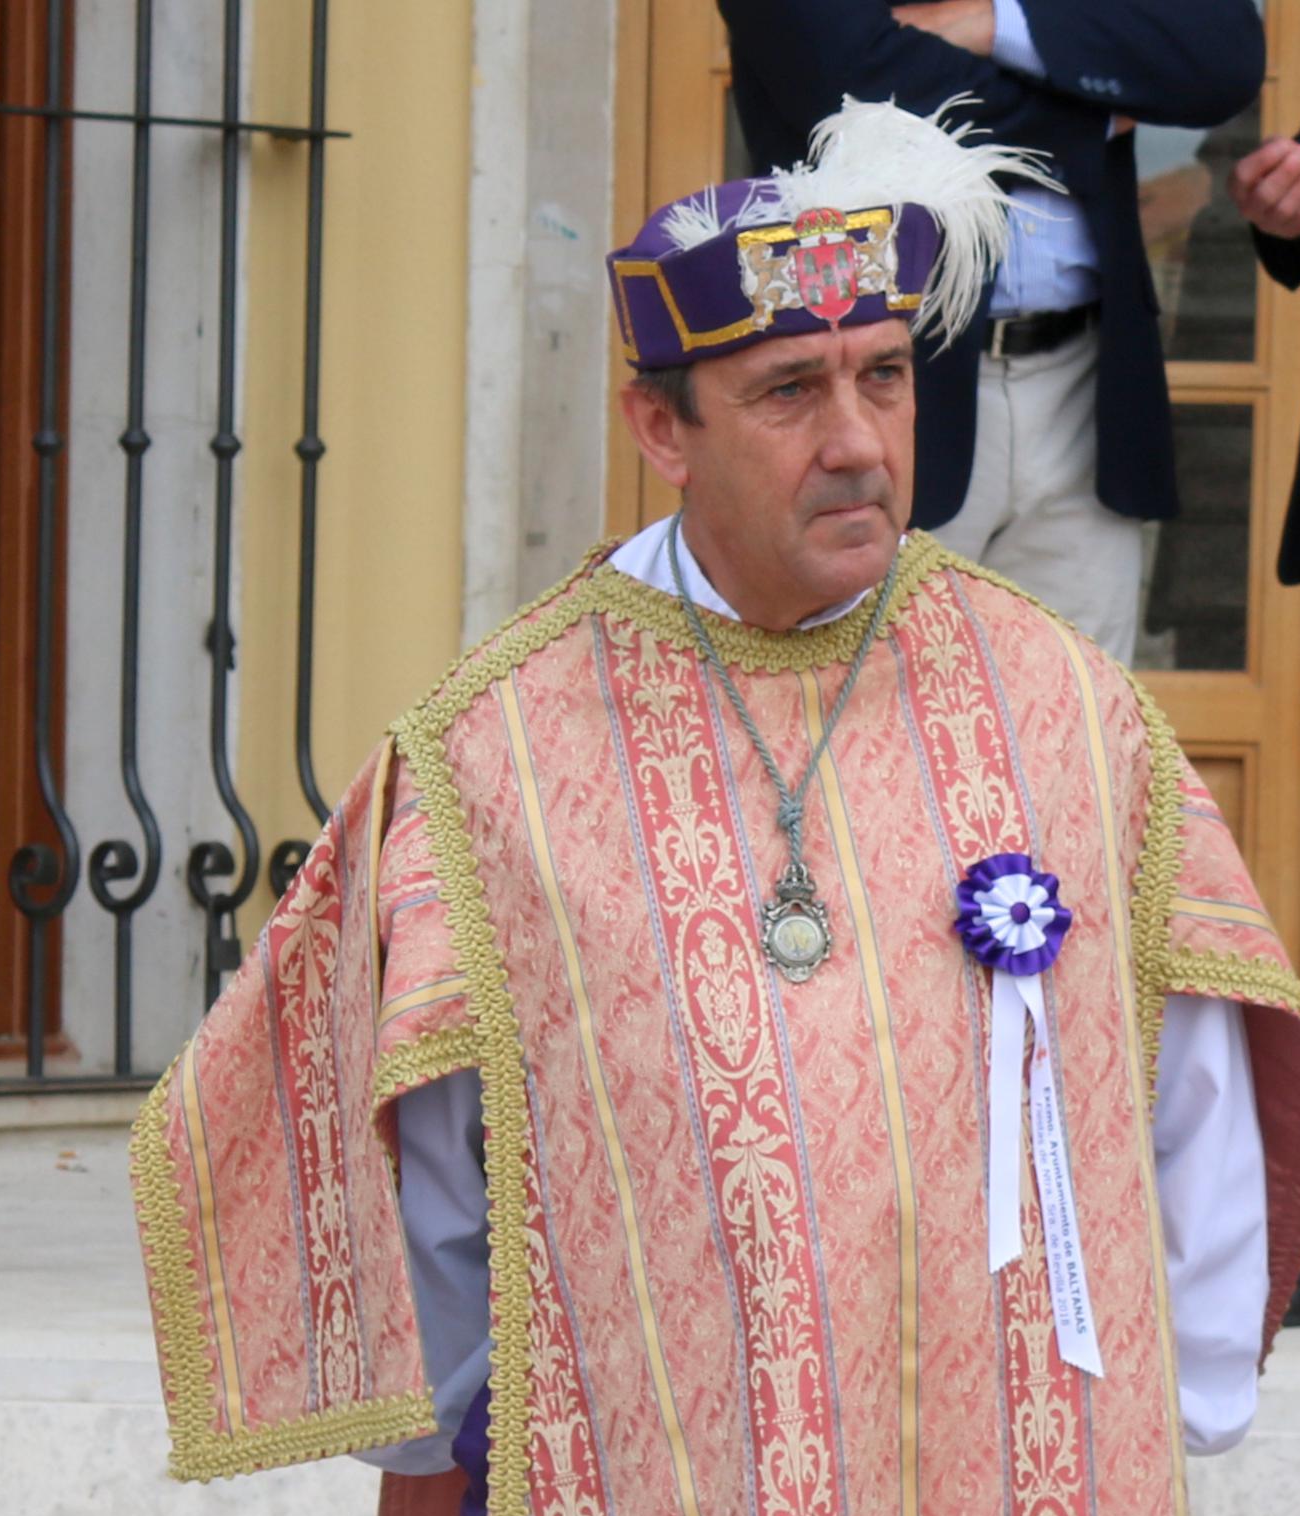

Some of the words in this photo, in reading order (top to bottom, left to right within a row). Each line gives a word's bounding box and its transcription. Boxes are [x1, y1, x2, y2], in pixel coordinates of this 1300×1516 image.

[1050, 1141, 1070, 1237] Ayuntamiento
[1063, 1240, 1073, 1258] de
[1050, 1233, 1059, 1249] de
